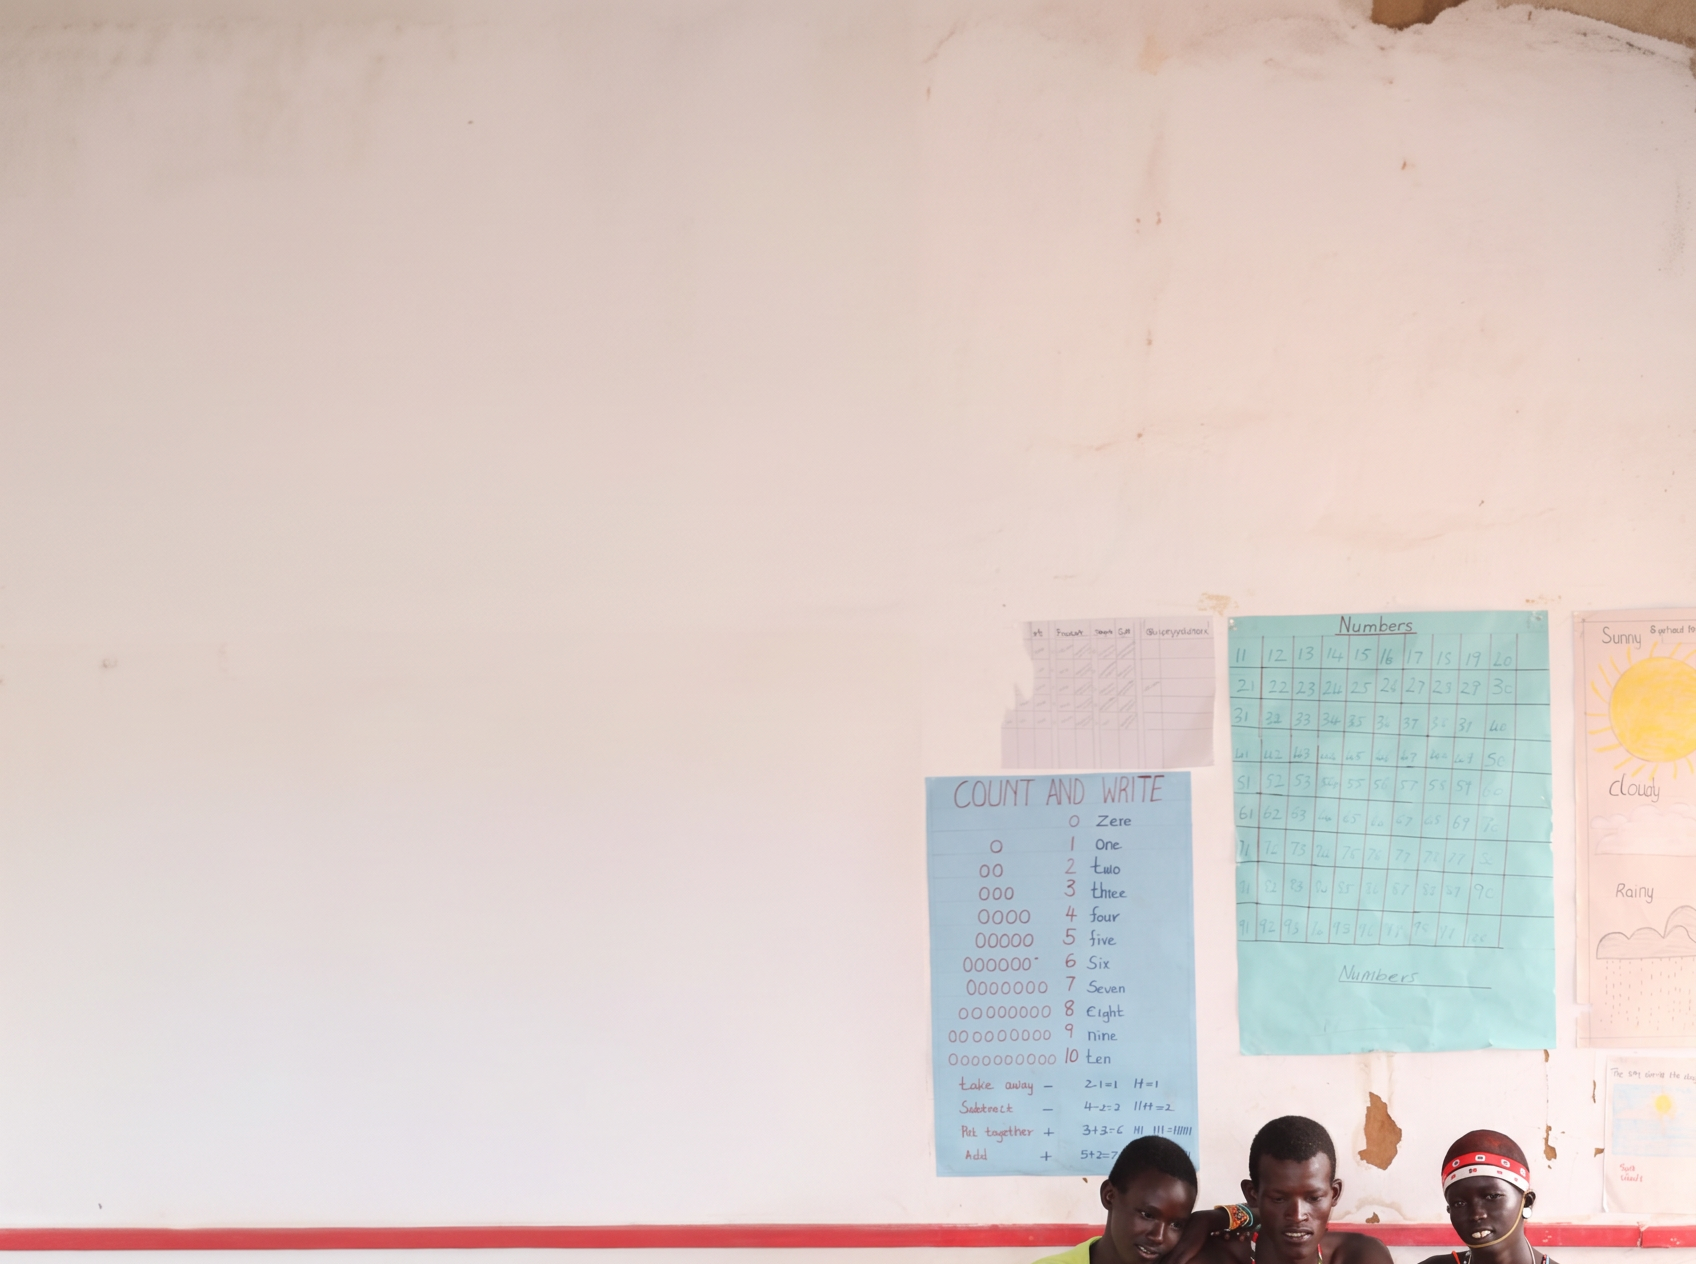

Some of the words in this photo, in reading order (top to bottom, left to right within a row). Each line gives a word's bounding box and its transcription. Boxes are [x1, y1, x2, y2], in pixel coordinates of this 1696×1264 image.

[1339, 616, 1412, 632] Numbers
[1602, 626, 1641, 650] Sunny
[1236, 648, 1246, 663] 11
[1268, 649, 1287, 662] 12
[1298, 646, 1314, 660] 13
[1327, 648, 1343, 662] 14
[1355, 648, 1372, 660] 15
[1380, 649, 1393, 665] 16
[1407, 649, 1423, 665] 17
[1466, 652, 1481, 667] 19
[1237, 679, 1254, 692] 21
[1269, 680, 1289, 693] 22
[1296, 682, 1315, 696] 23
[1323, 681, 1343, 695] 24
[1351, 682, 1372, 693] 25
[1406, 677, 1425, 694] 27
[1460, 680, 1481, 695] 29
[1233, 707, 1248, 723] 31
[1294, 712, 1311, 726] 33
[1321, 713, 1341, 726] 34
[1403, 717, 1419, 729] 37
[1237, 775, 1250, 790] 51
[1267, 773, 1285, 788] 52
[1295, 773, 1311, 788] 53
[1347, 778, 1366, 788] 55
[1374, 777, 1388, 789] 56
[954, 779, 1035, 808] COUNT
[1046, 778, 1084, 805] AND
[1102, 775, 1164, 803] WRITE
[1239, 805, 1253, 820] 61
[1263, 805, 1283, 820] 62
[1291, 806, 1307, 821] 63
[1453, 815, 1470, 831] 69
[1071, 837, 1074, 851] 1
[1096, 839, 1122, 850] One
[1065, 859, 1076, 874] 2
[1090, 856, 1120, 874] two
[1064, 879, 1076, 897] 3
[1091, 882, 1127, 898] three
[1616, 884, 1654, 903] Rainy
[1066, 906, 1077, 922] 4
[1090, 906, 1120, 923] four
[1239, 919, 1249, 936] 91
[1259, 918, 1275, 934] 92
[1063, 928, 1076, 945] 5
[1090, 930, 1116, 946] five
[1065, 953, 1076, 968] 6
[1087, 956, 1109, 969] Six
[1339, 965, 1418, 983] Numbers
[1065, 976, 1075, 991] 7
[1087, 980, 1125, 993] Seven
[1064, 1000, 1074, 1016] 8
[1087, 1005, 1124, 1022] Eight
[1065, 1024, 1073, 1038] 9
[1088, 1031, 1117, 1041] nine
[1065, 1048, 1078, 1063] 10
[1086, 1049, 1111, 1064] ten
[959, 1076, 994, 1090] take
[1005, 1081, 1033, 1095] away
[962, 1125, 977, 1138] Put
[985, 1126, 1034, 1143] together
[965, 1148, 987, 1160] Add
